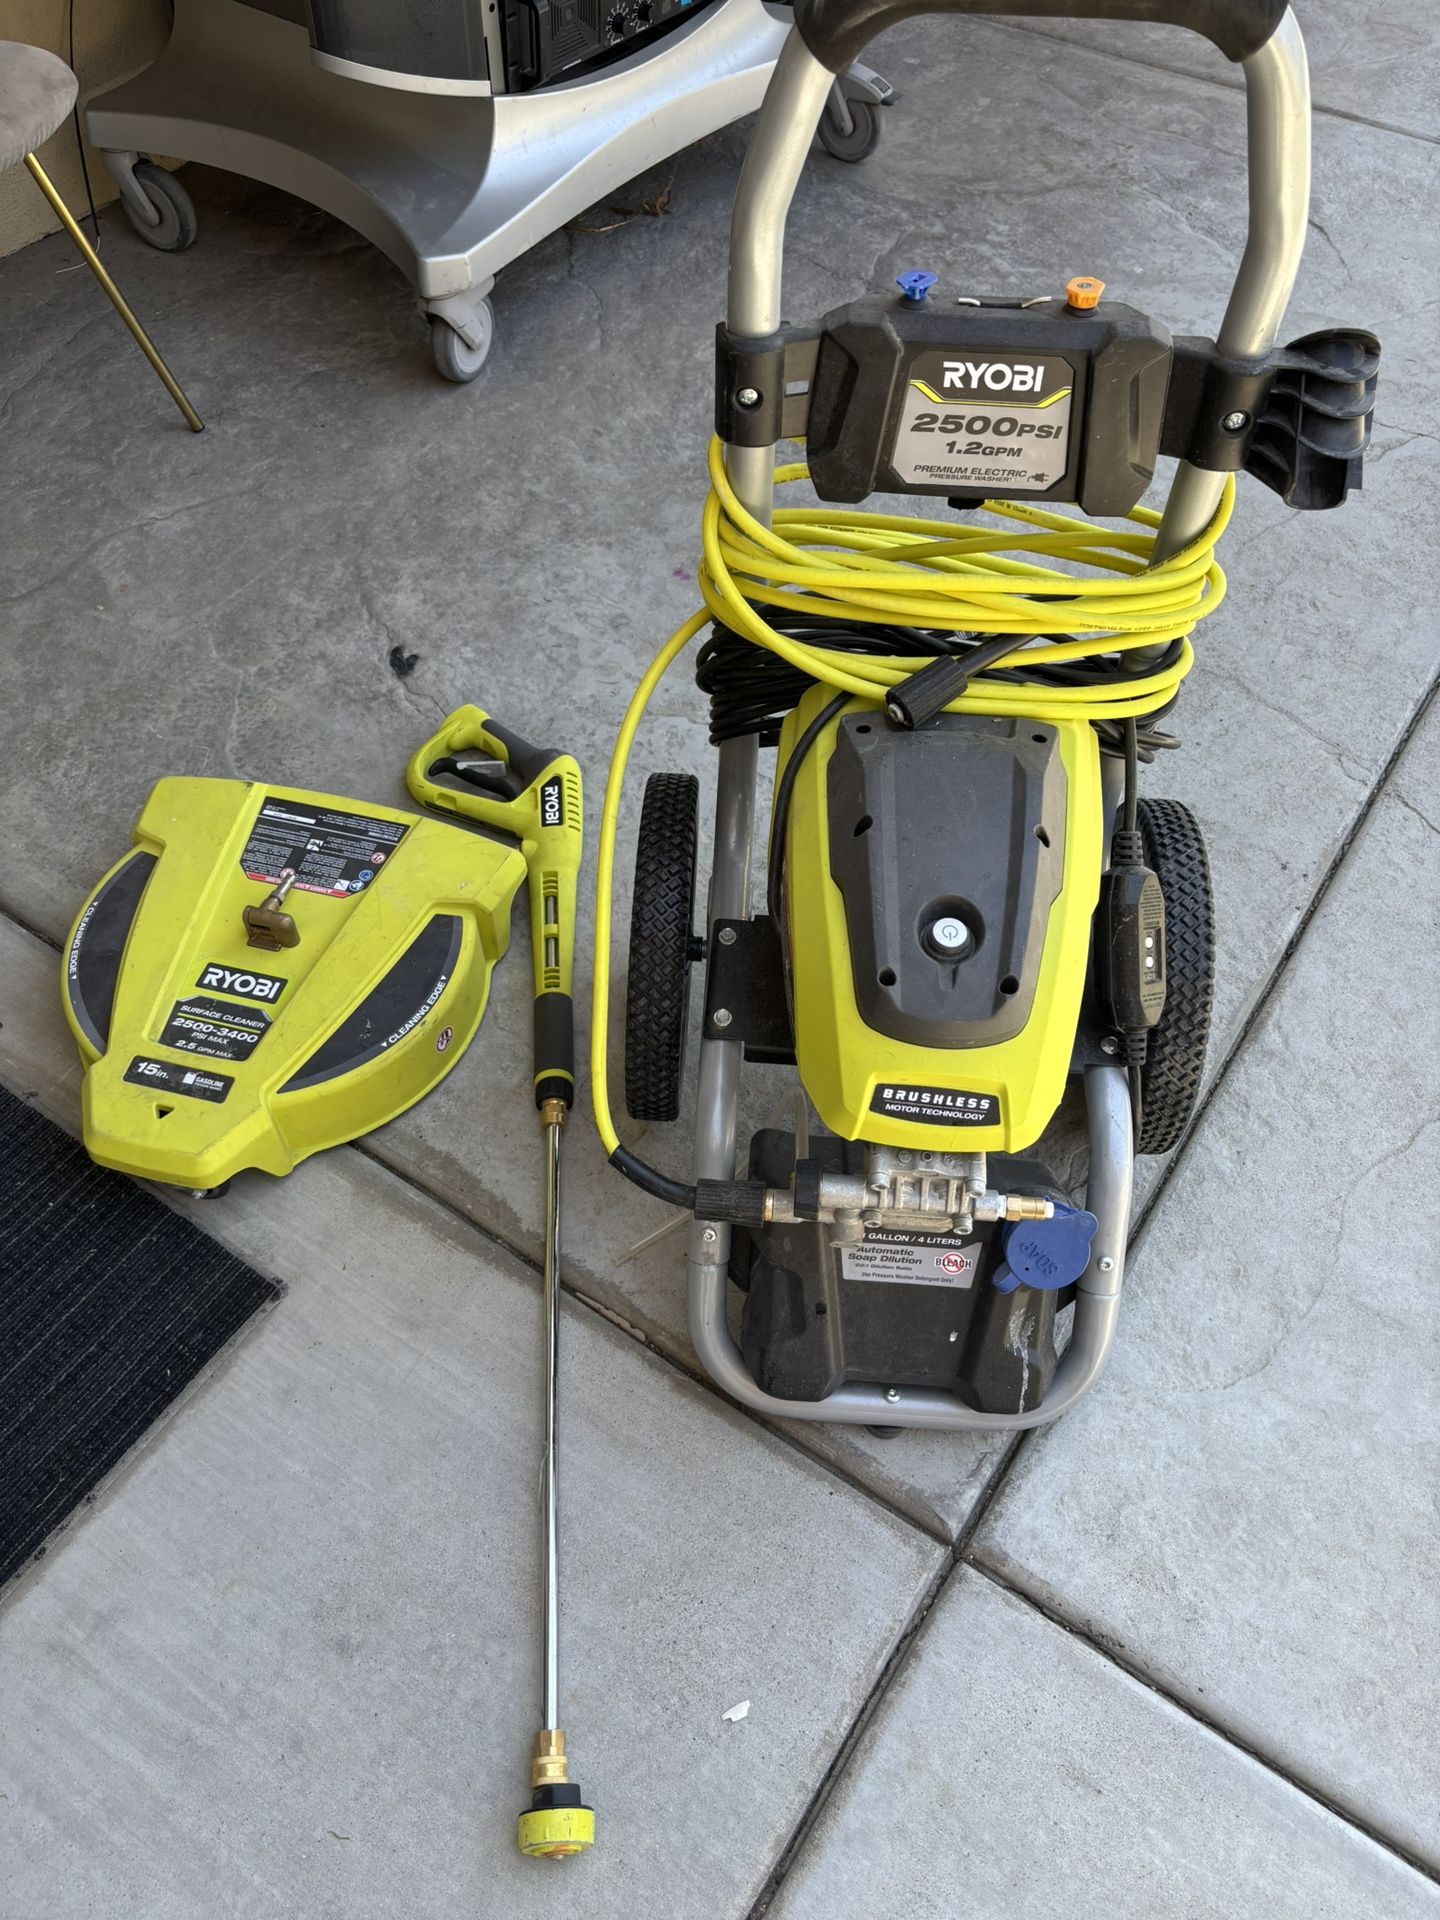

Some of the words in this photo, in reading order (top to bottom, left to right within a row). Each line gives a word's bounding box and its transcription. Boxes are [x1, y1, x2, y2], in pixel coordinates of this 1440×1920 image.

[943, 361, 1045, 392] RYOBI
[910, 413, 1063, 440] 2500PSI
[945, 441, 1023, 458] 1.2GPM
[913, 464, 968, 475] PREMIUM
[970, 467, 1027, 478] ELECTRIC
[929, 473, 972, 481] PRESSURE
[545, 785, 560, 824] RYOBI
[73, 907, 95, 948] CLEANING
[69, 950, 79, 974] EDGE
[203, 967, 280, 999] RYOBI
[180, 1005, 222, 1018] SURFACE
[222, 1014, 265, 1029] CLEANER
[388, 1004, 430, 1043] CLEANING
[426, 981, 446, 1005] EDGE
[171, 1017, 258, 1043] 2500-3400
[191, 1031, 208, 1040] PSI
[208, 1035, 229, 1045] MAX
[197, 1046, 215, 1054] GPM
[195, 1076, 225, 1088] GASOLINE
[882, 1088, 990, 1110] BRUSHLESS
[885, 1103, 920, 1114] MOTOR
[921, 1107, 985, 1121] TECHNOLOGY
[868, 1232, 910, 1242] GALLON
[926, 1237, 962, 1246] LITERS
[848, 1253, 877, 1262] Soap
[879, 1255, 922, 1265] Dilution
[856, 1246, 914, 1256] Automatic
[1019, 1241, 1058, 1278] SOAP
[935, 1257, 972, 1268] BLEACH
